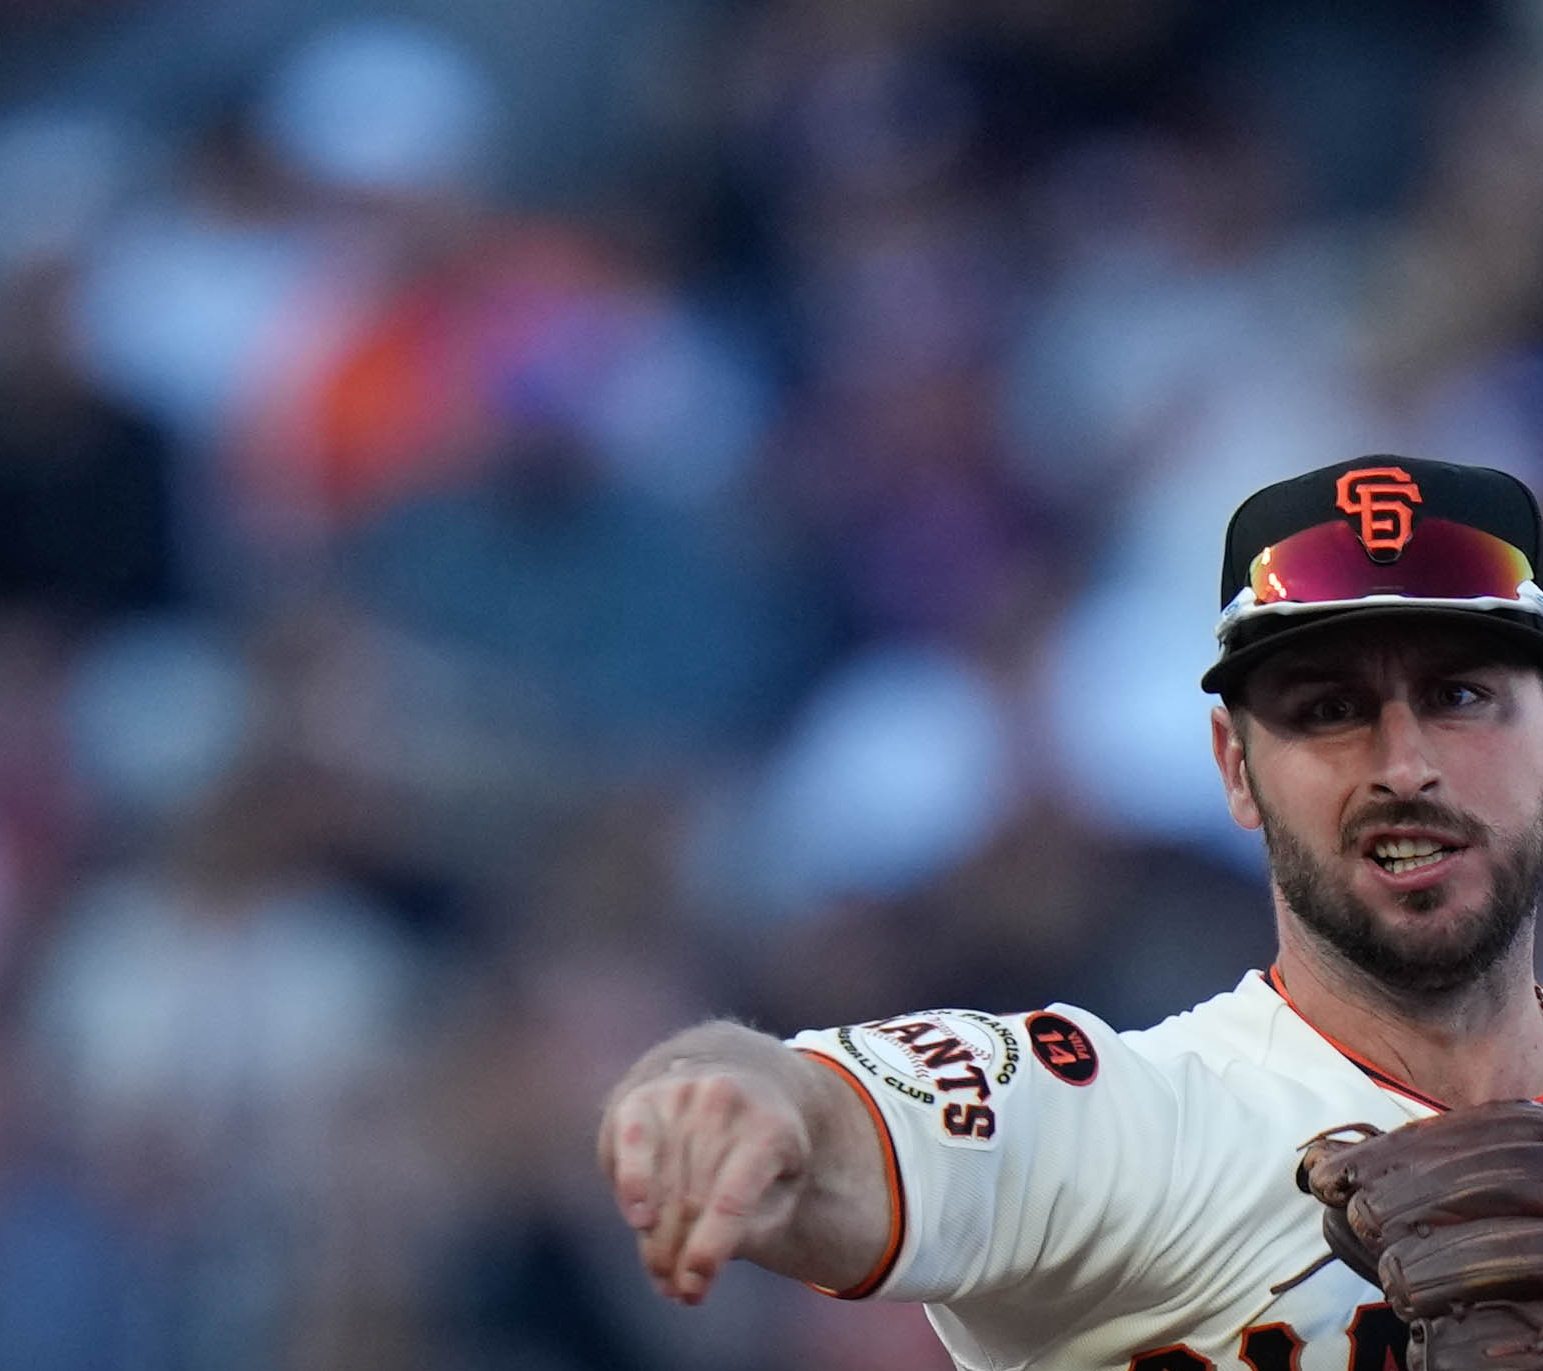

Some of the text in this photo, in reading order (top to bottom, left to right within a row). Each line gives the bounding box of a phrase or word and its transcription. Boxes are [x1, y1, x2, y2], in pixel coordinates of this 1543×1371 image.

[960, 1012, 1020, 1085] FRANCISCO
[1037, 1030, 1077, 1065] 14
[884, 1076, 936, 1105] CLUB
